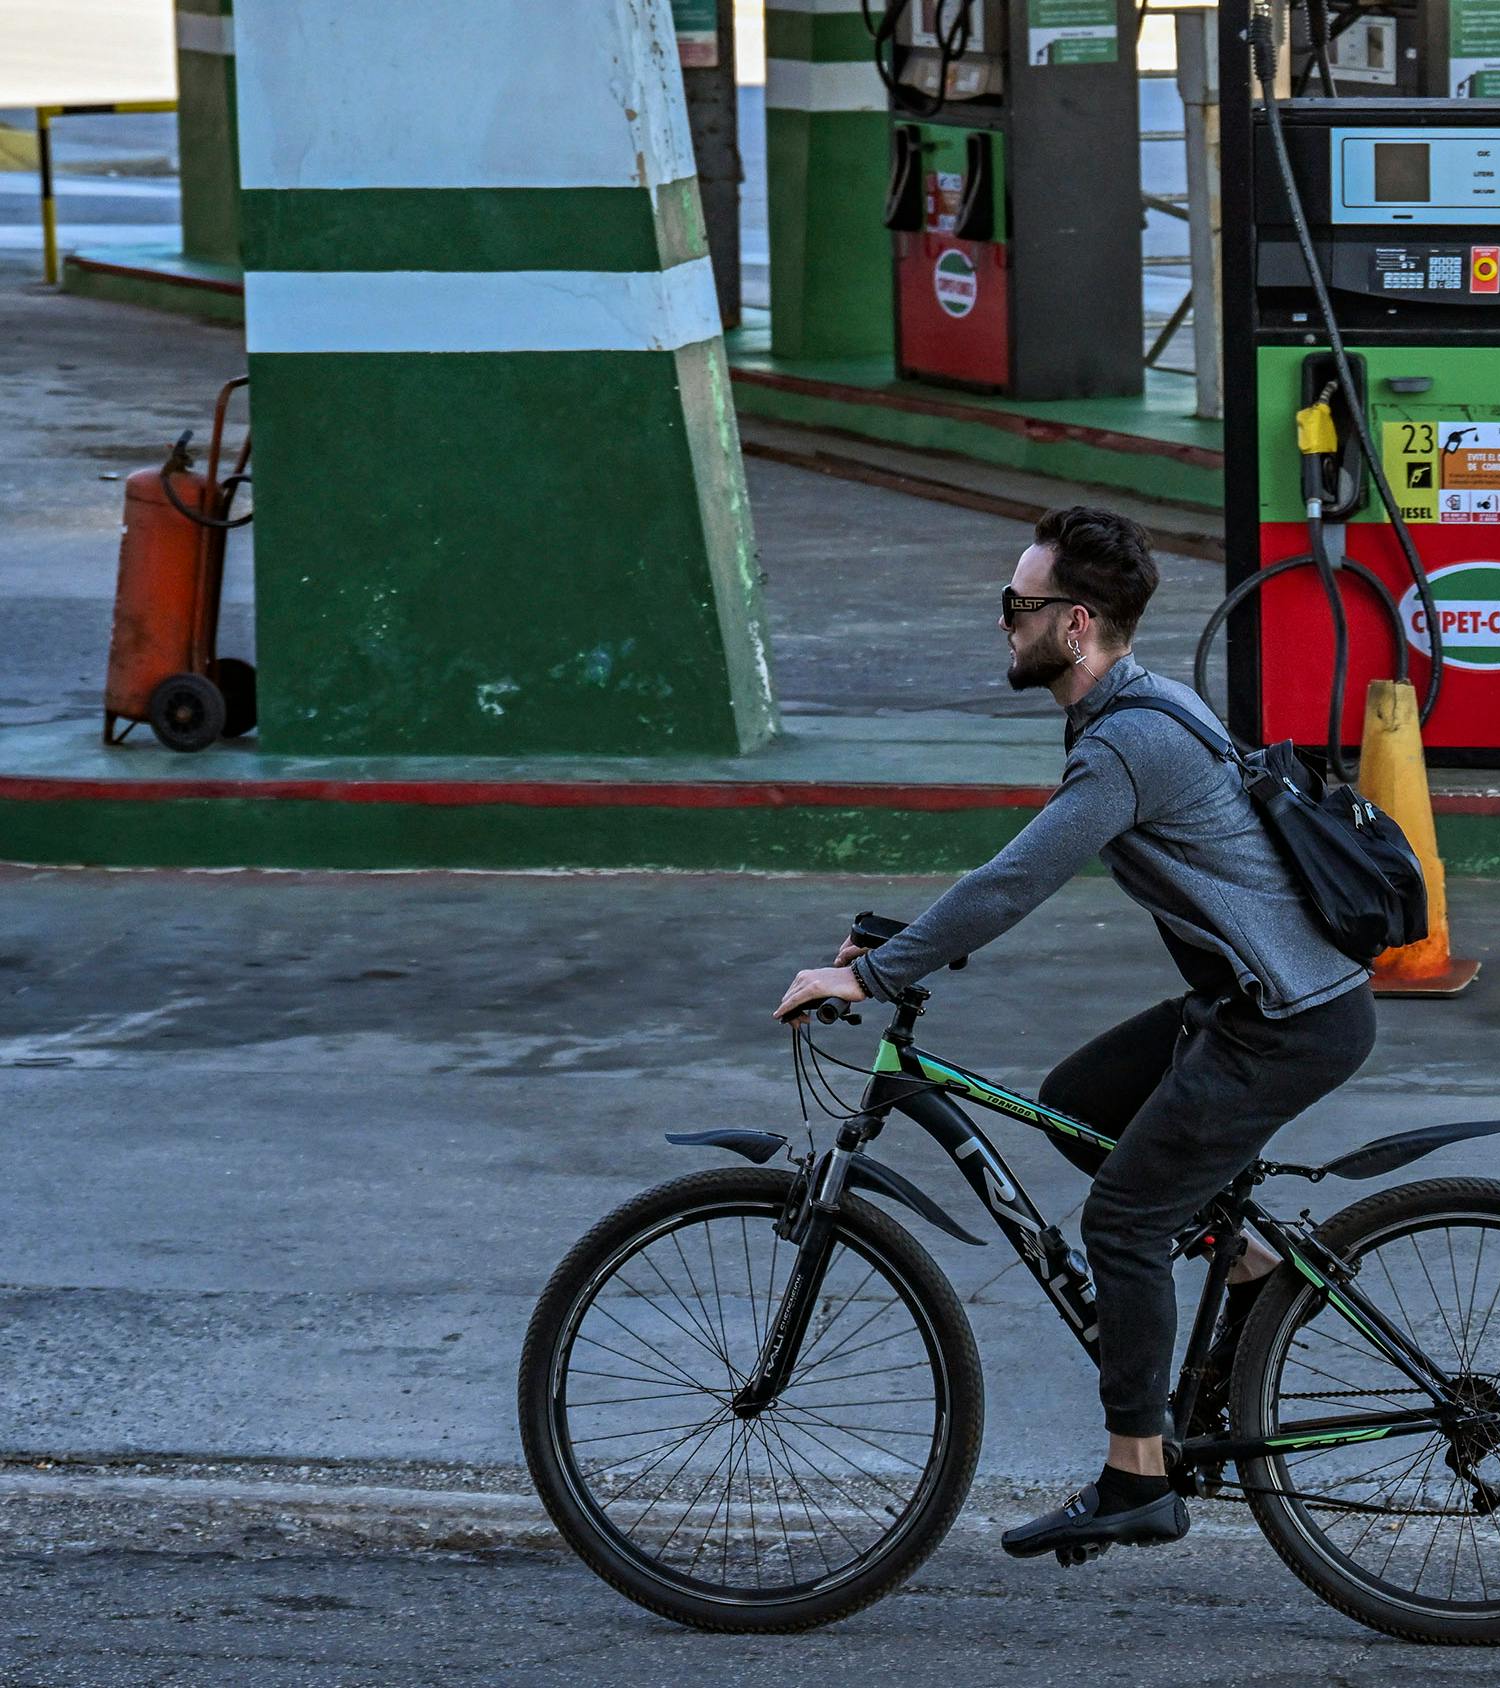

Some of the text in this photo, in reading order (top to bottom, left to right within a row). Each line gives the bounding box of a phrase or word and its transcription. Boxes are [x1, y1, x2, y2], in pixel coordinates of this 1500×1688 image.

[1401, 424, 1434, 454] 23
[1400, 507, 1433, 519] IESEL
[987, 1095, 1032, 1117] TORNADO
